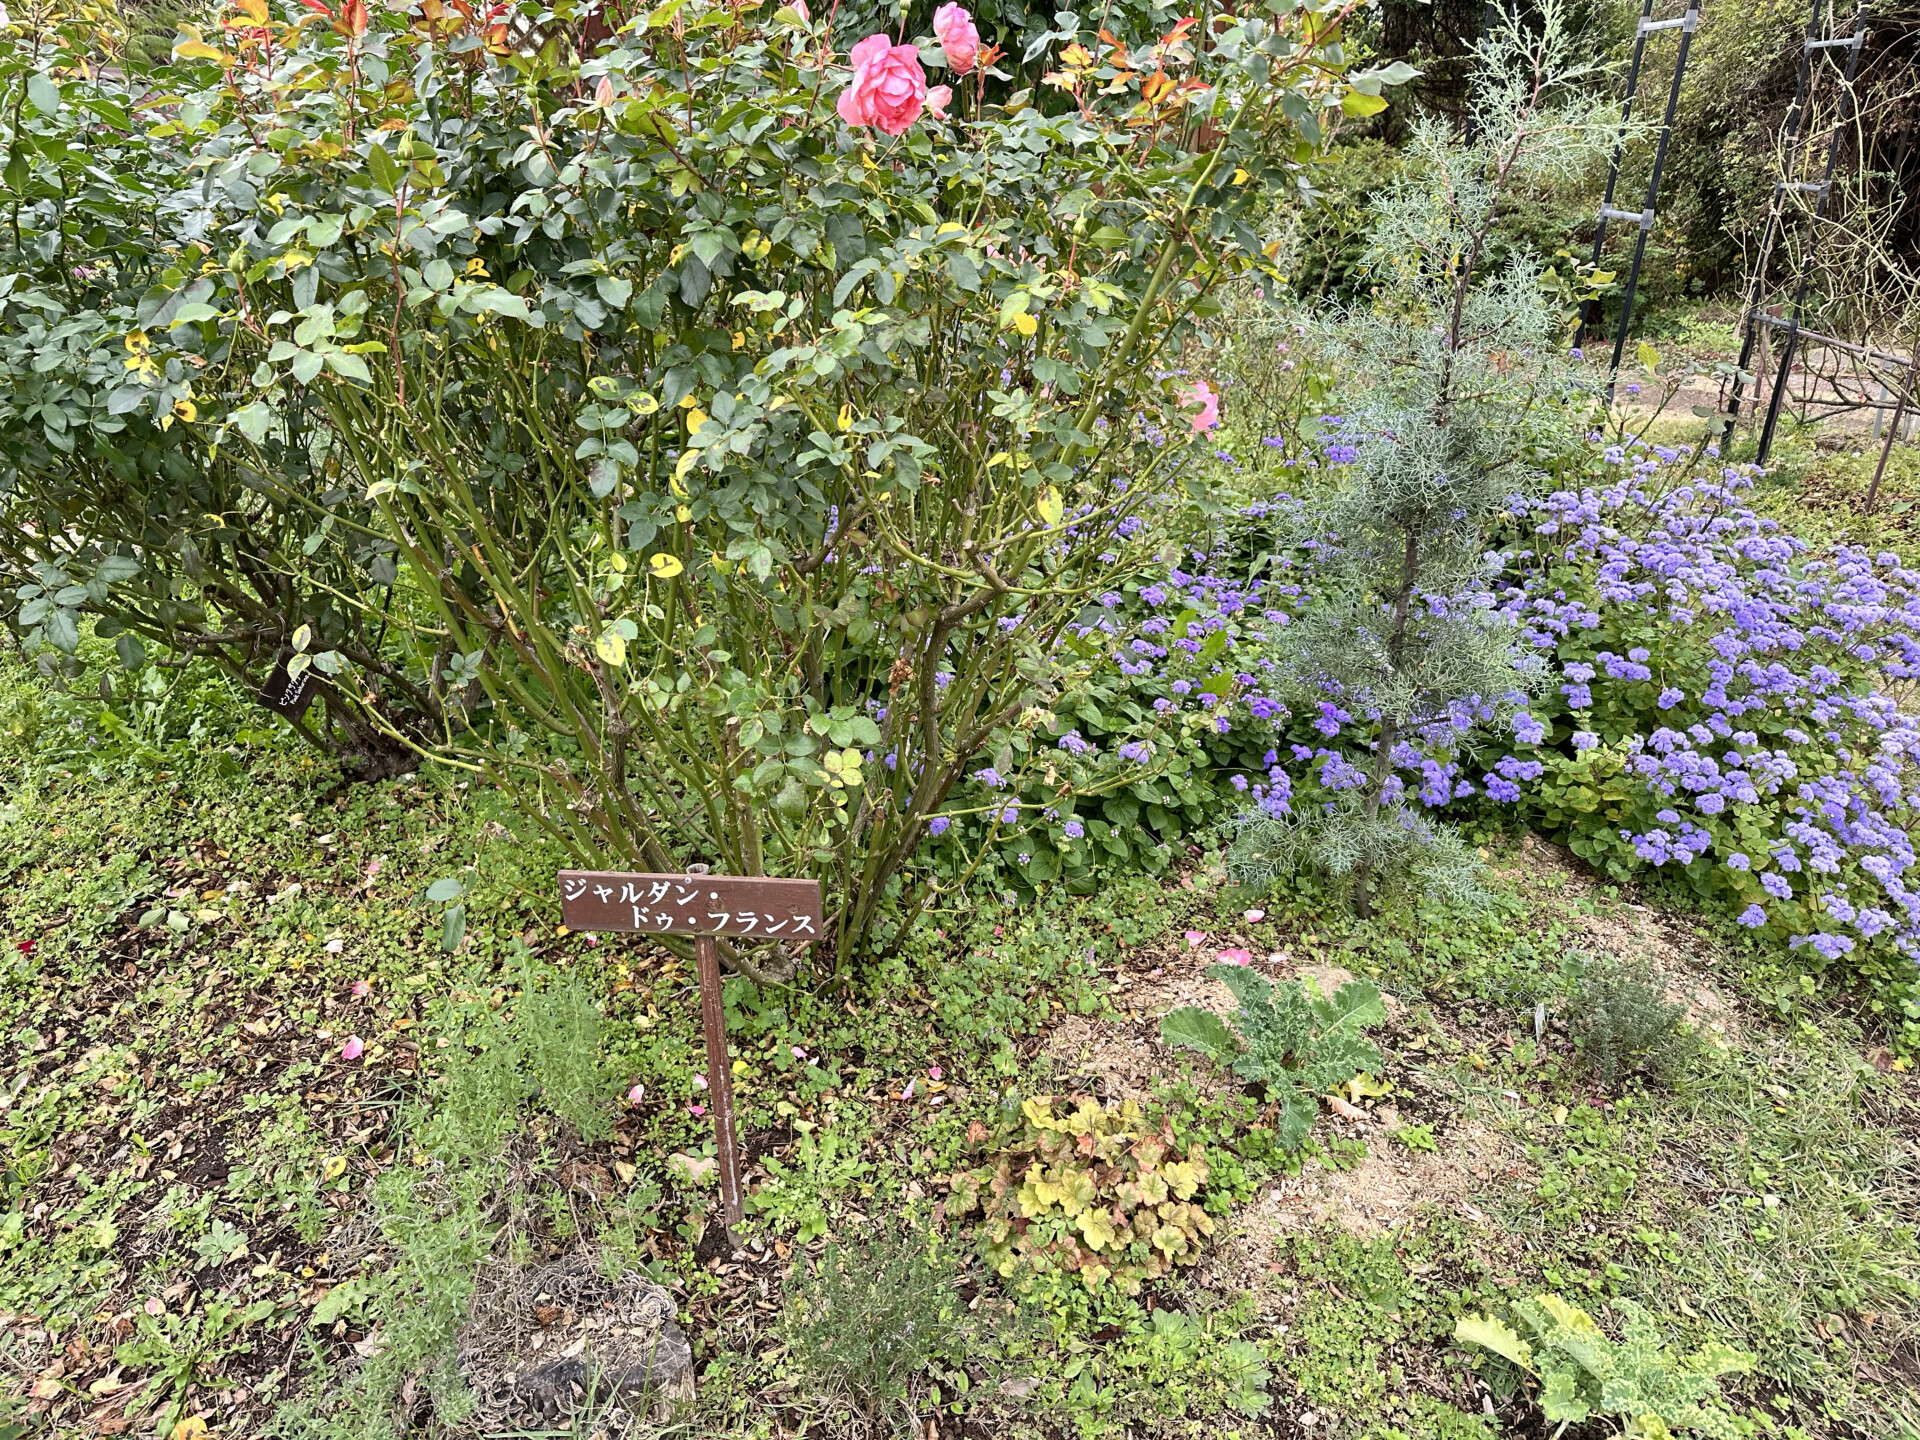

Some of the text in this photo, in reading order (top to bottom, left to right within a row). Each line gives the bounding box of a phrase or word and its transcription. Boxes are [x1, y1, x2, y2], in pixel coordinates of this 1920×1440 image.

[564, 878, 719, 906] ジャルダン・
[631, 905, 816, 934] ドゥ・フランス
